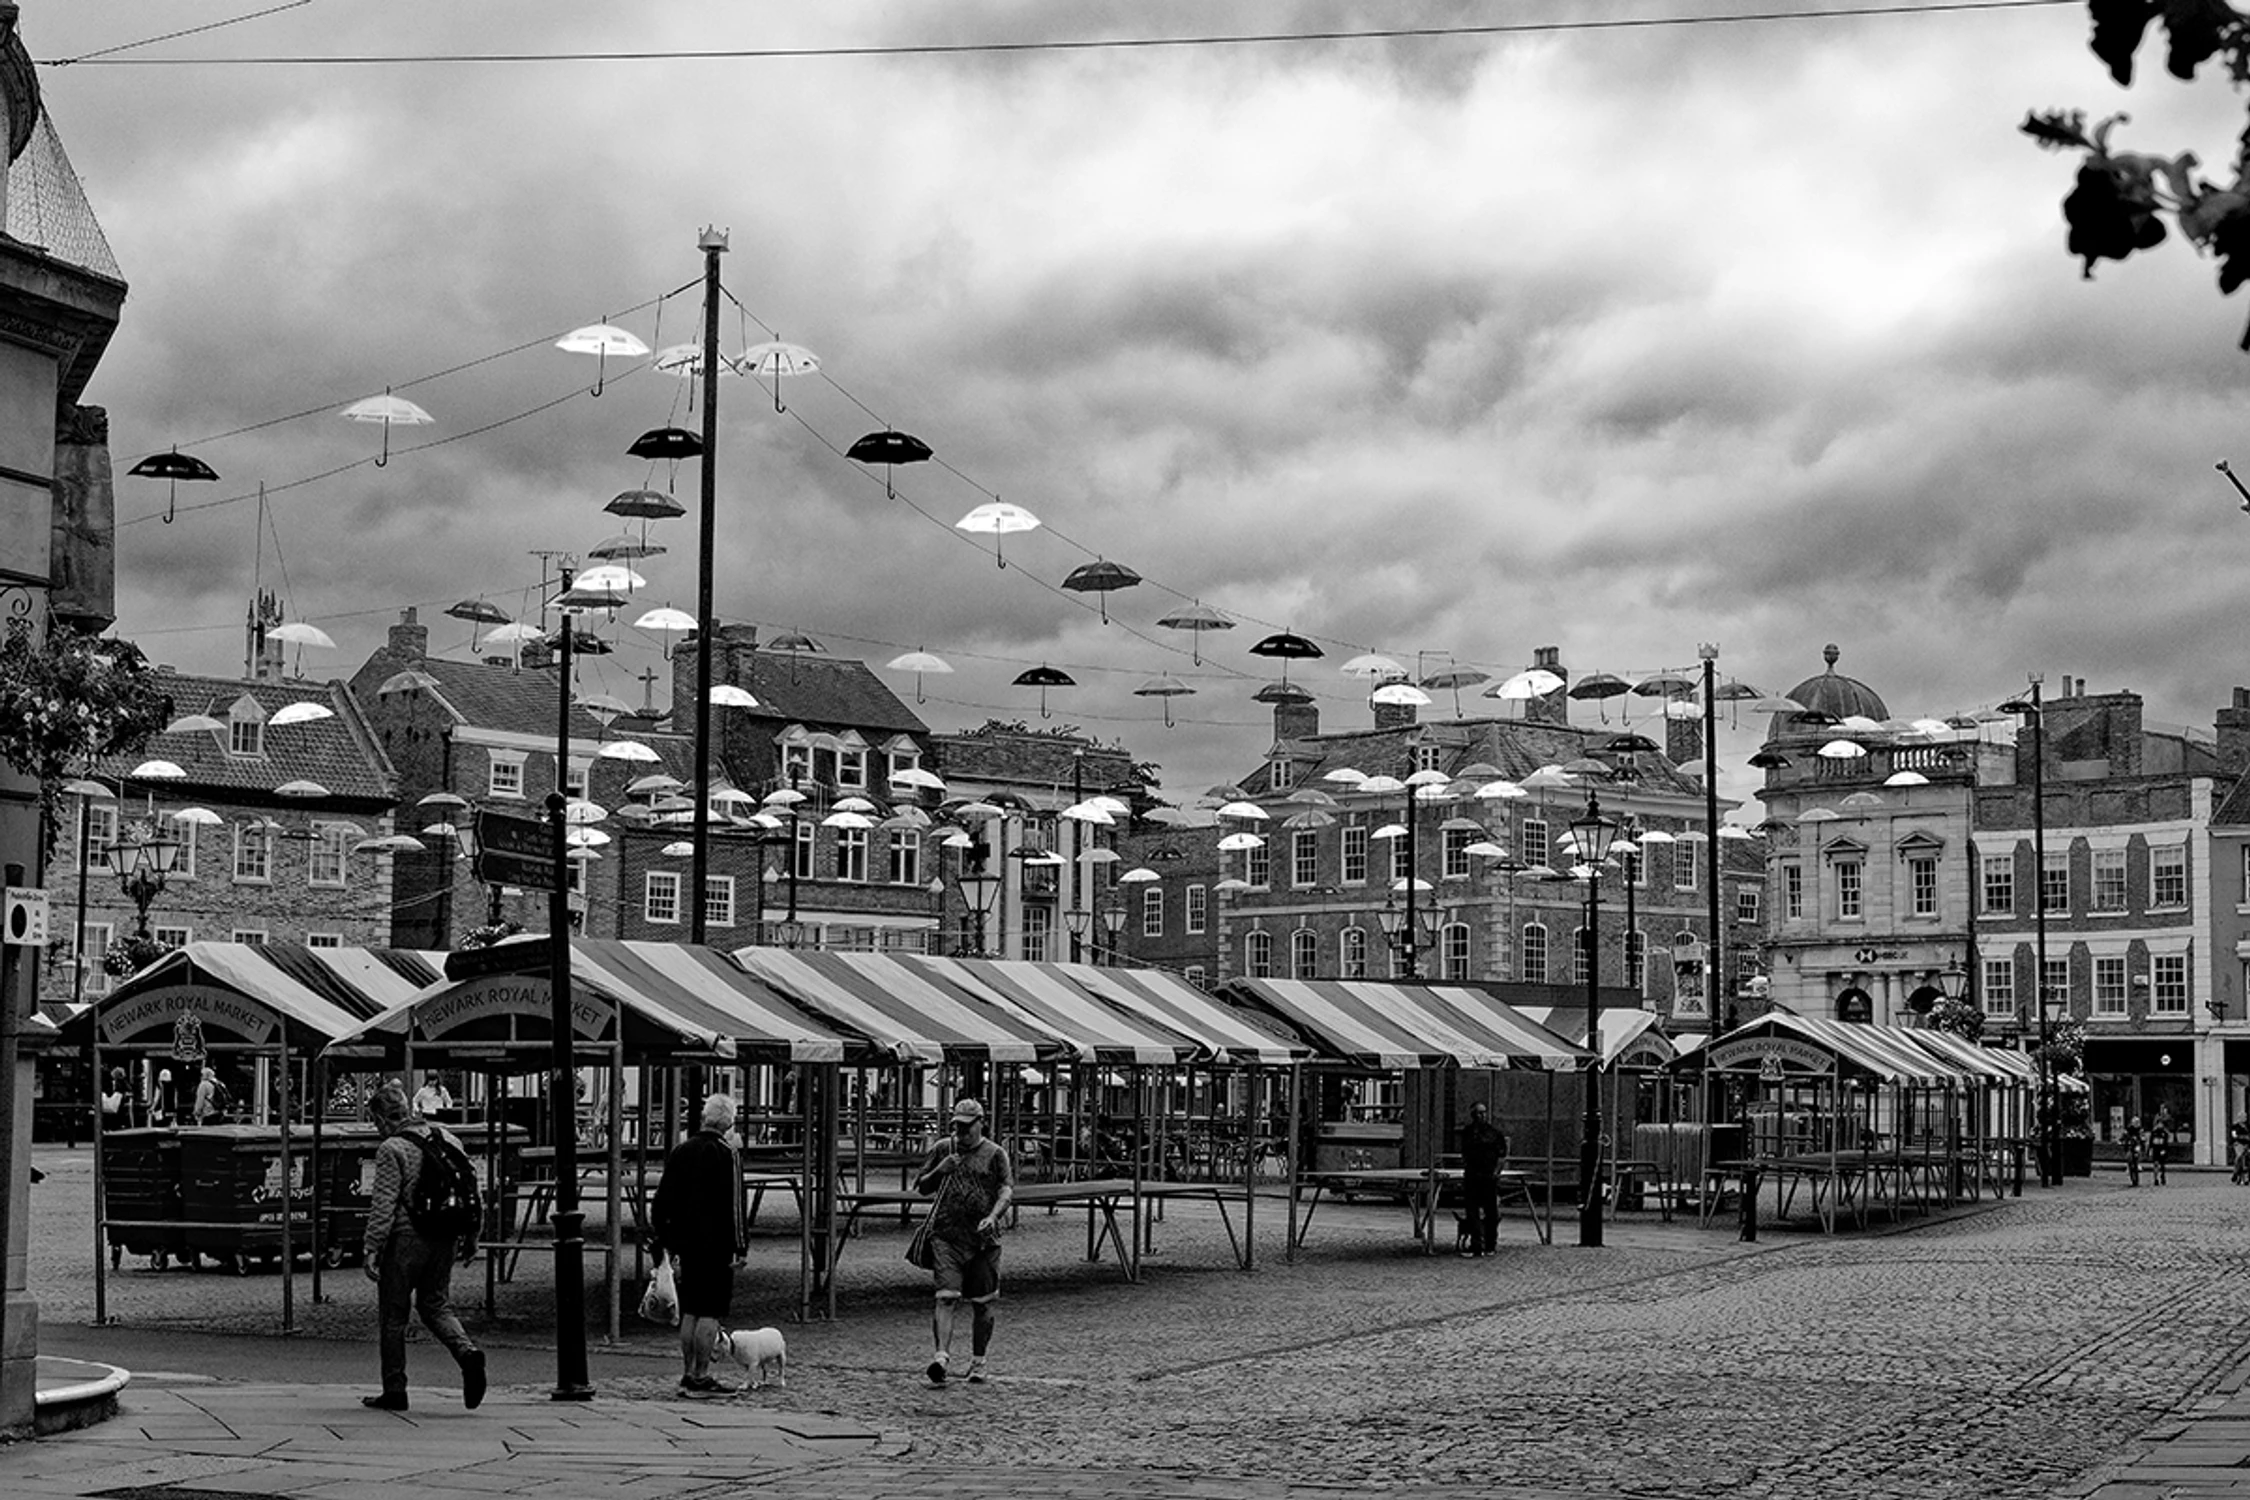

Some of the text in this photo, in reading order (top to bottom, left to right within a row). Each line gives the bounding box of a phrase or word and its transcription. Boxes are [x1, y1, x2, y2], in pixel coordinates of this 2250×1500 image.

[108, 995, 265, 1034] NEWARK ROYAL MARKET
[425, 987, 602, 1028] NEWARK ROYAL MKET
[1755, 1041, 1787, 1052] ROYAL
